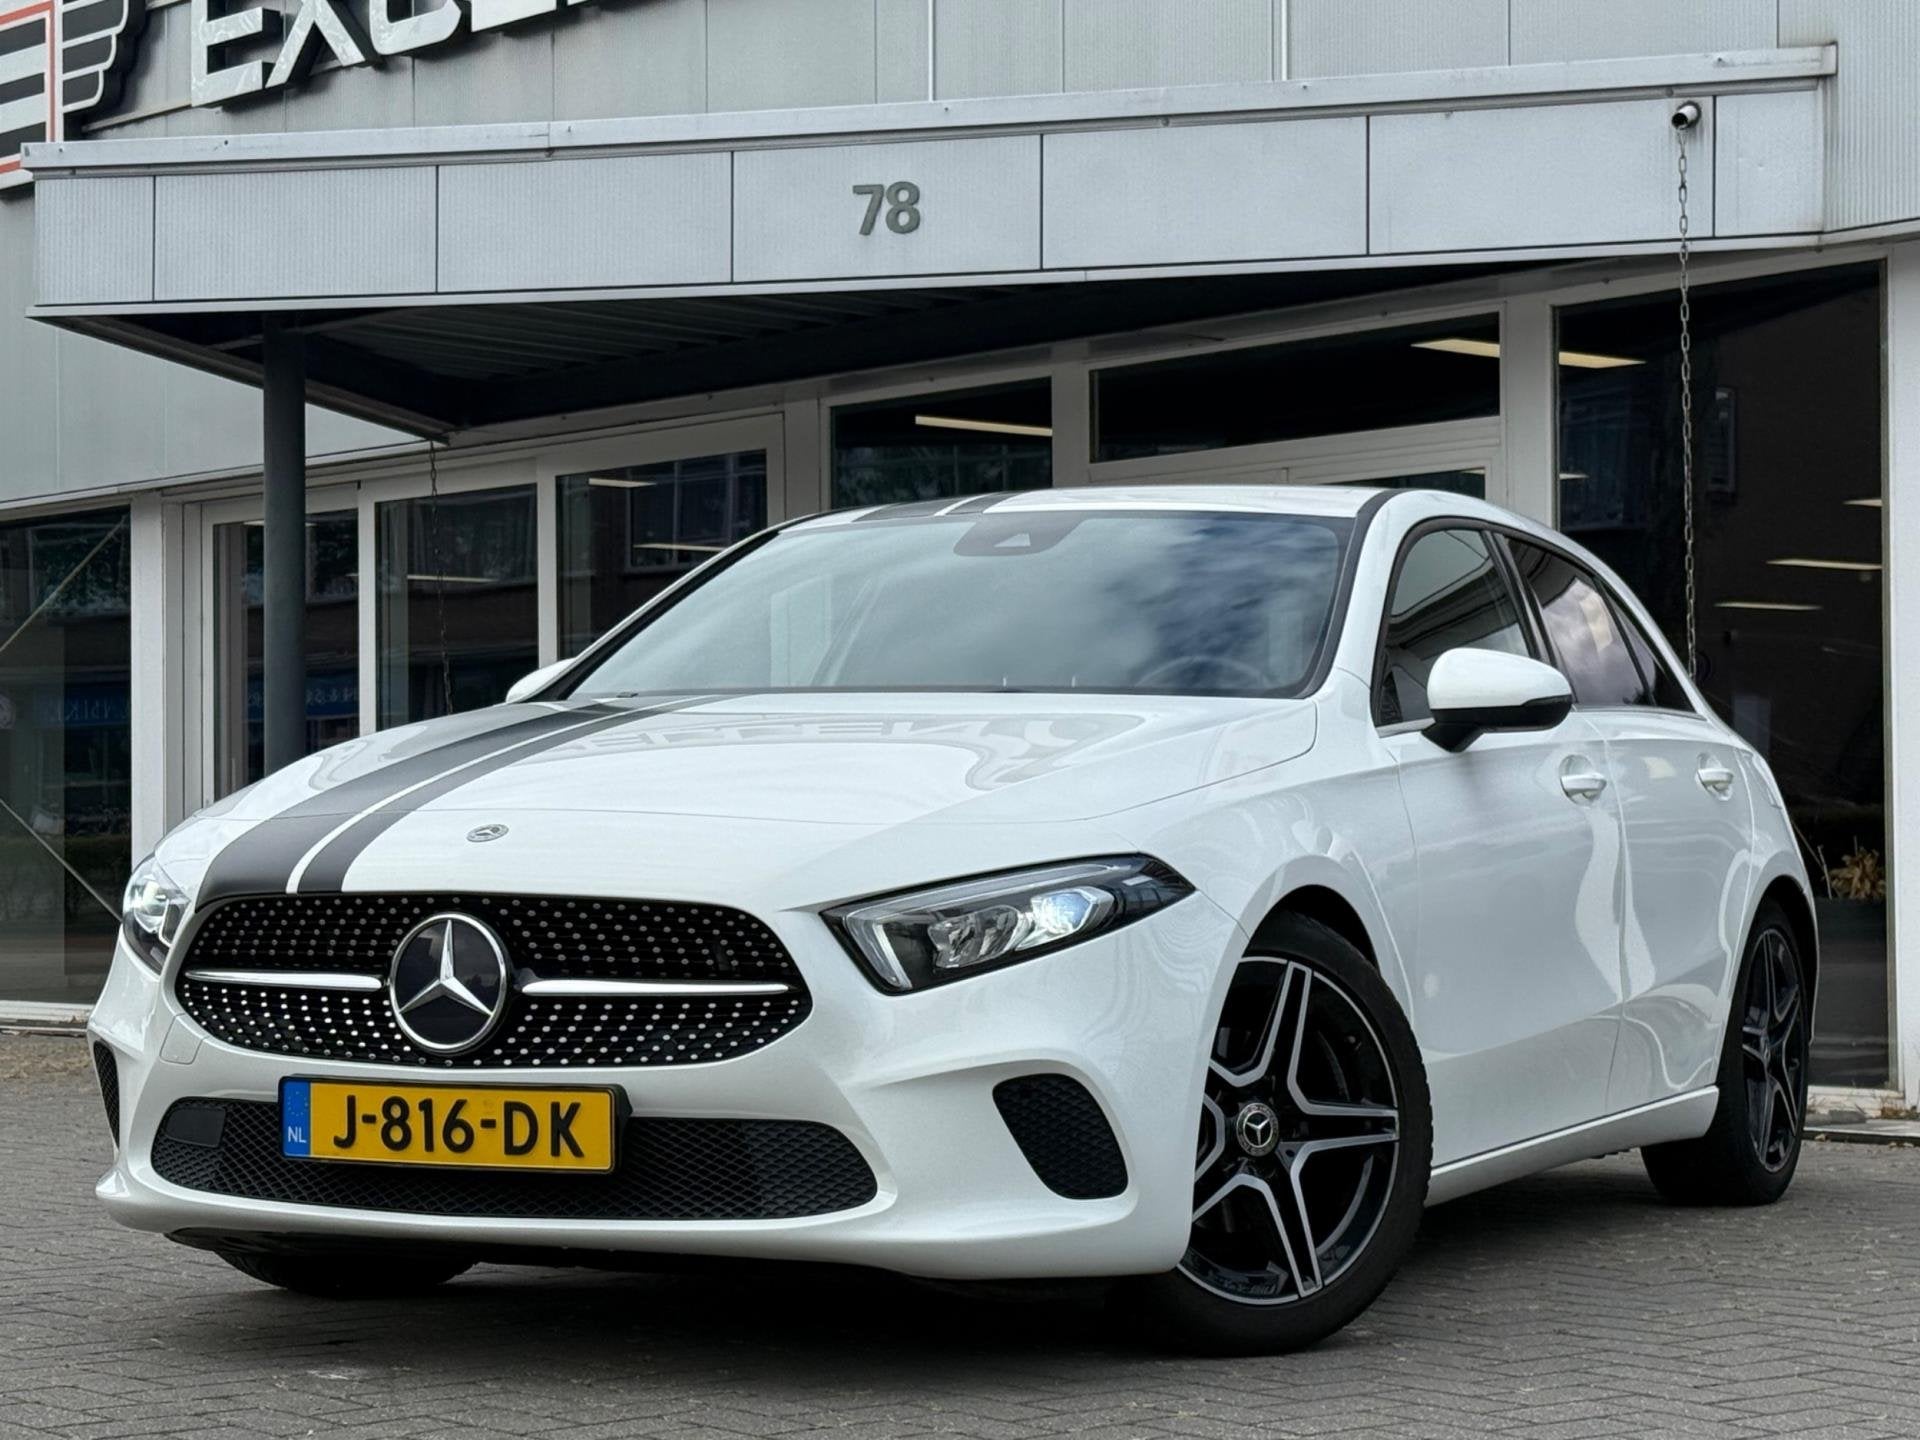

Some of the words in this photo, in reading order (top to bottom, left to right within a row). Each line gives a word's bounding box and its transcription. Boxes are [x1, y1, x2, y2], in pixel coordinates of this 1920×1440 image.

[852, 181, 921, 236] 78
[287, 1126, 307, 1145] NL
[333, 1095, 585, 1158] J-816-DK
